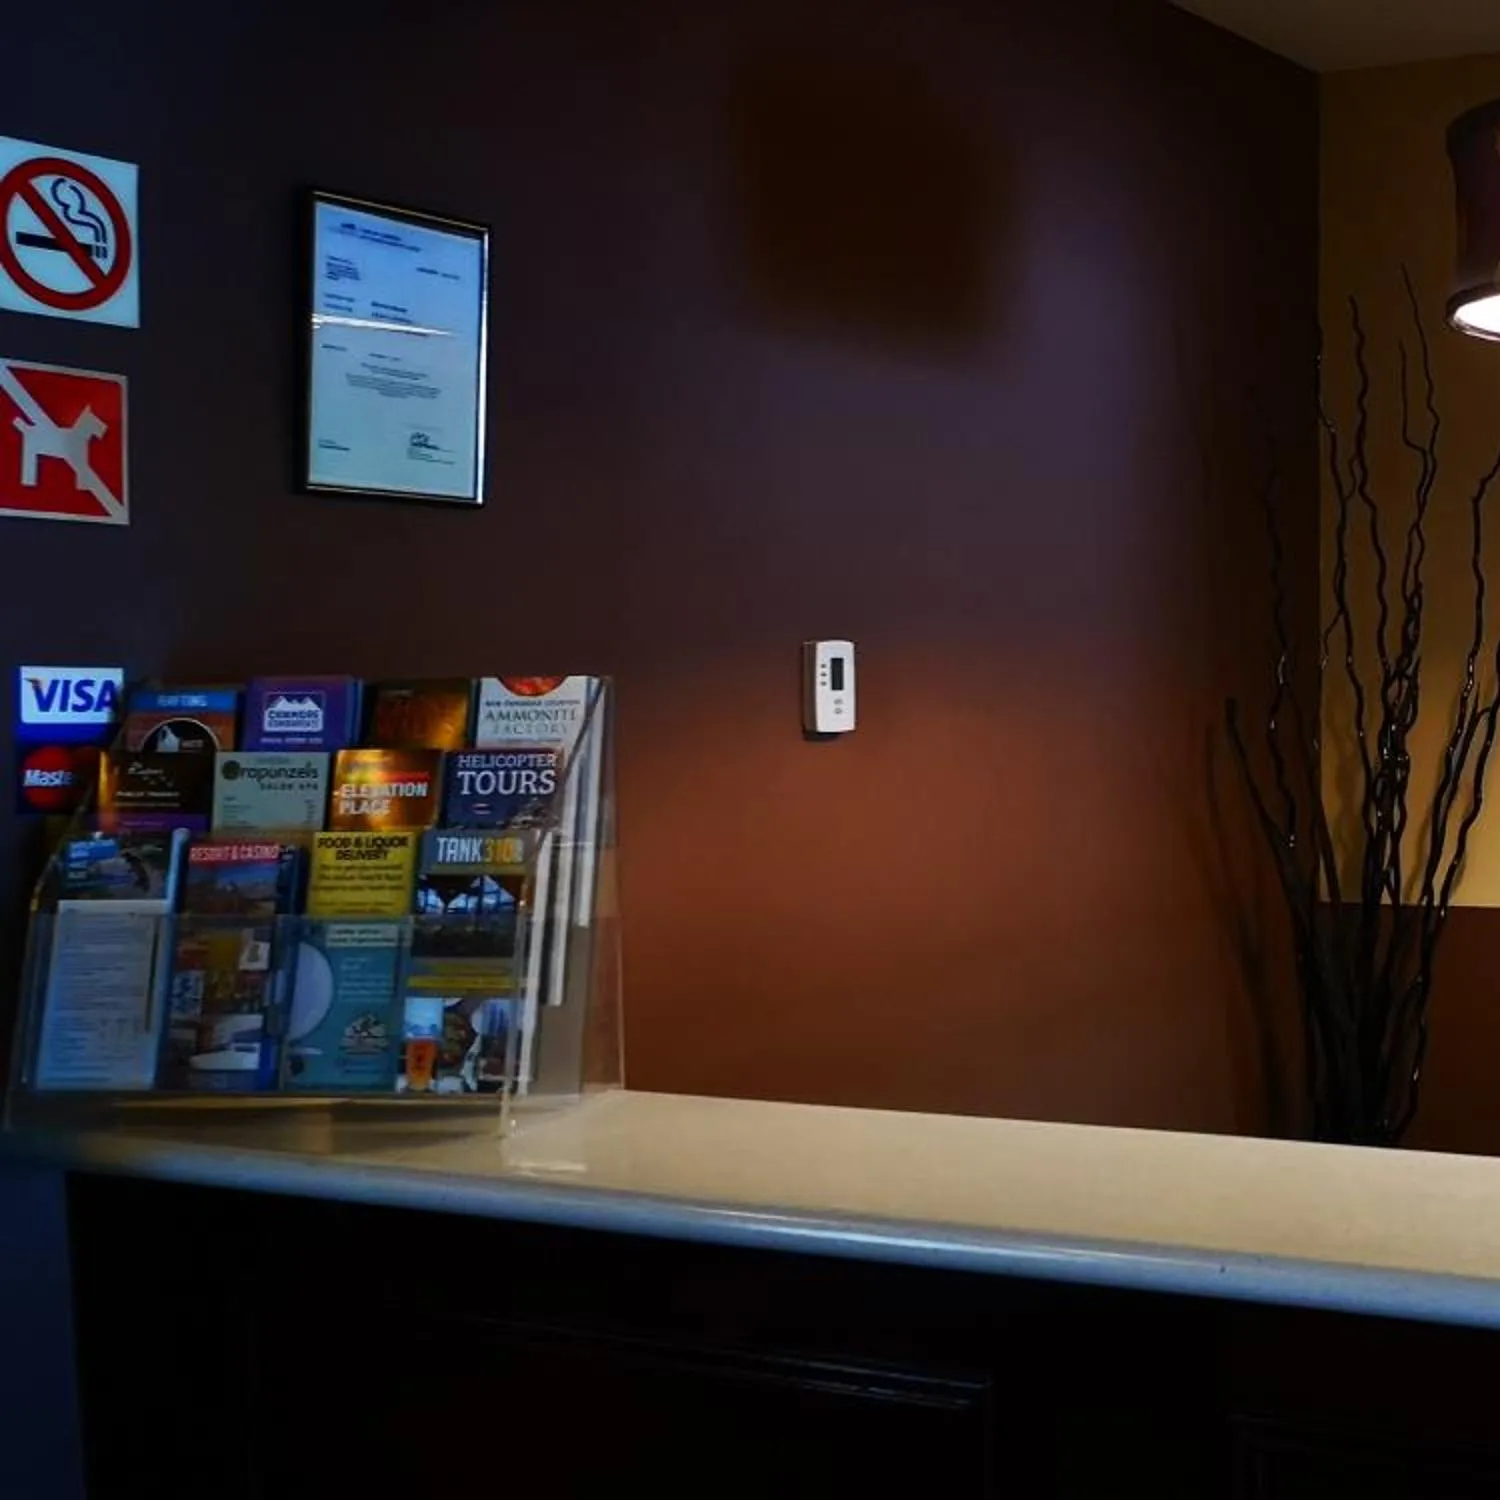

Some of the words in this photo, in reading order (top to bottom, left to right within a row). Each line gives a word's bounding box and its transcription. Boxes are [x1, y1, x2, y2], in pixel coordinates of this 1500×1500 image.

[25, 678, 118, 713] VISA
[457, 753, 557, 768] HELICOPTER
[457, 769, 556, 796] TOURS
[318, 837, 352, 849] FOOD
[335, 849, 389, 861] DELIVERY
